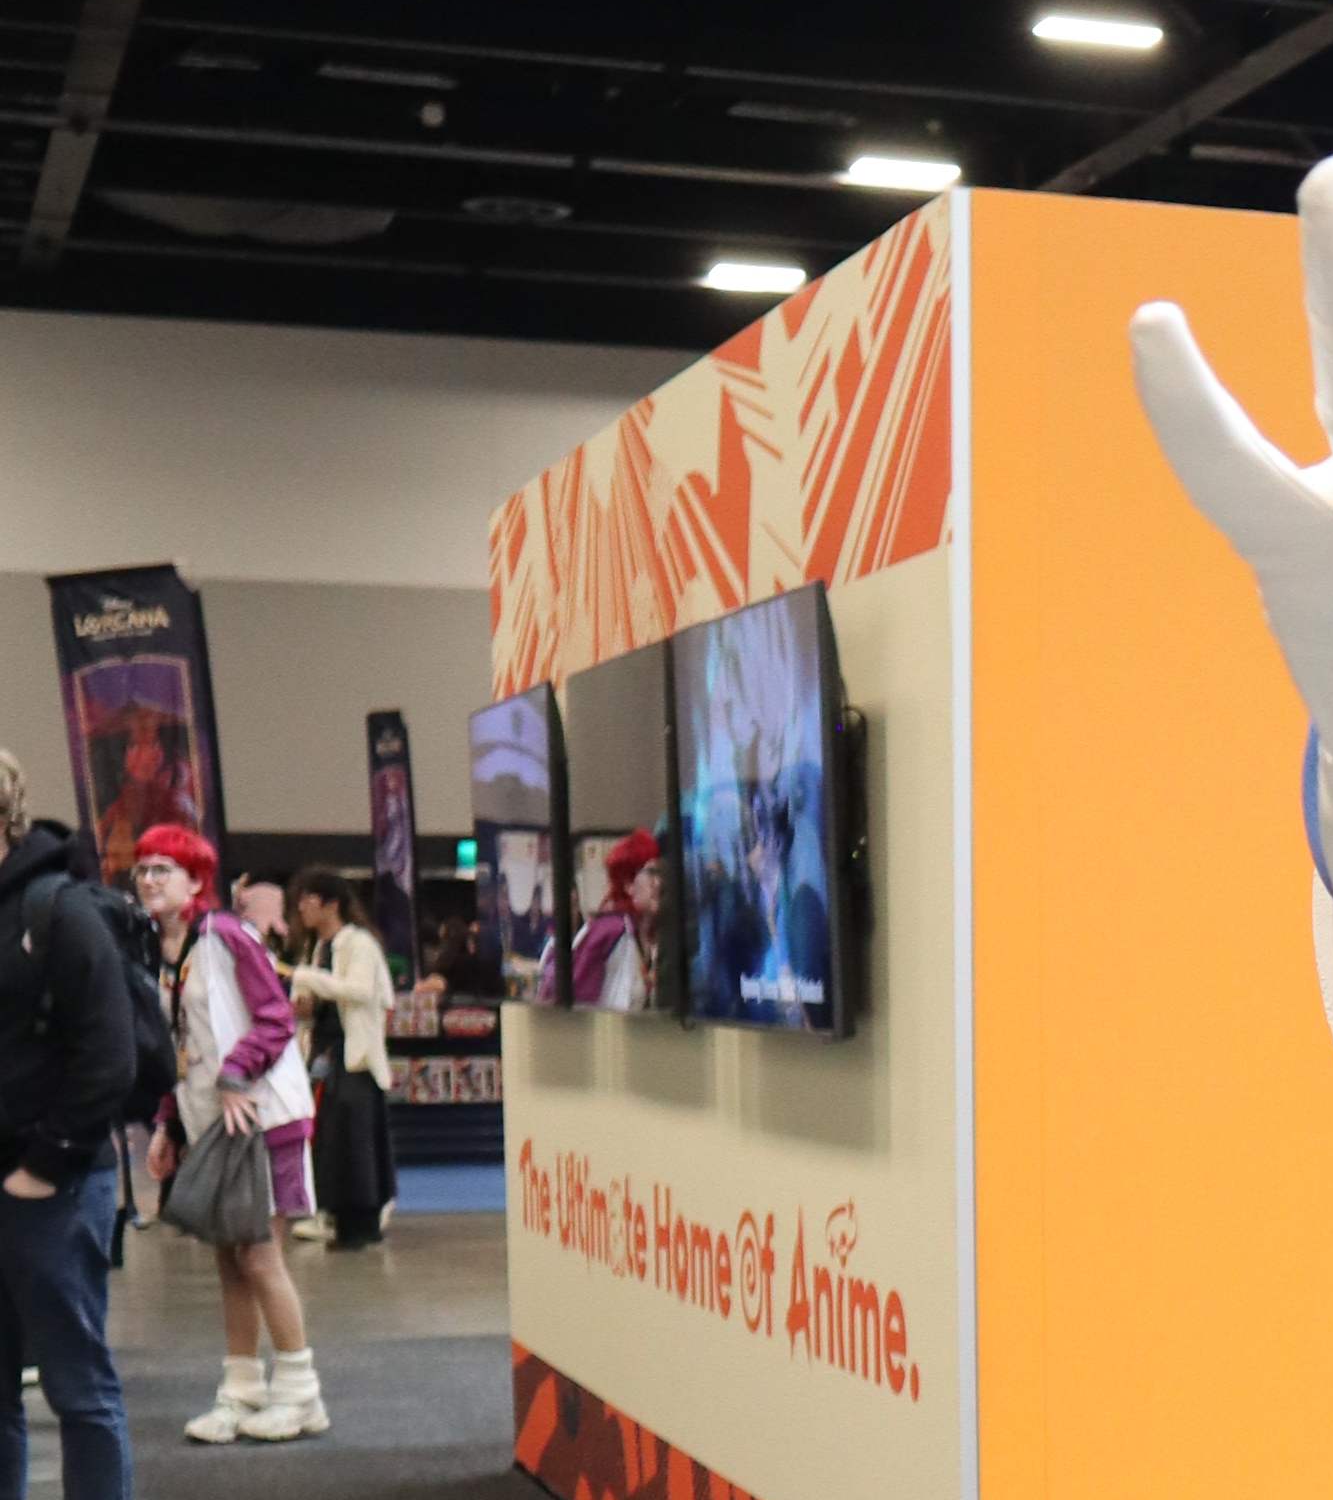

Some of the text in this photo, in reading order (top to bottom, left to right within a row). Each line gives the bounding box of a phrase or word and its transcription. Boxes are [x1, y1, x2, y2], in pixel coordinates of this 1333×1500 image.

[518, 1136, 551, 1239] The
[653, 1180, 732, 1321] Home
[785, 1197, 920, 1404] Anime.
